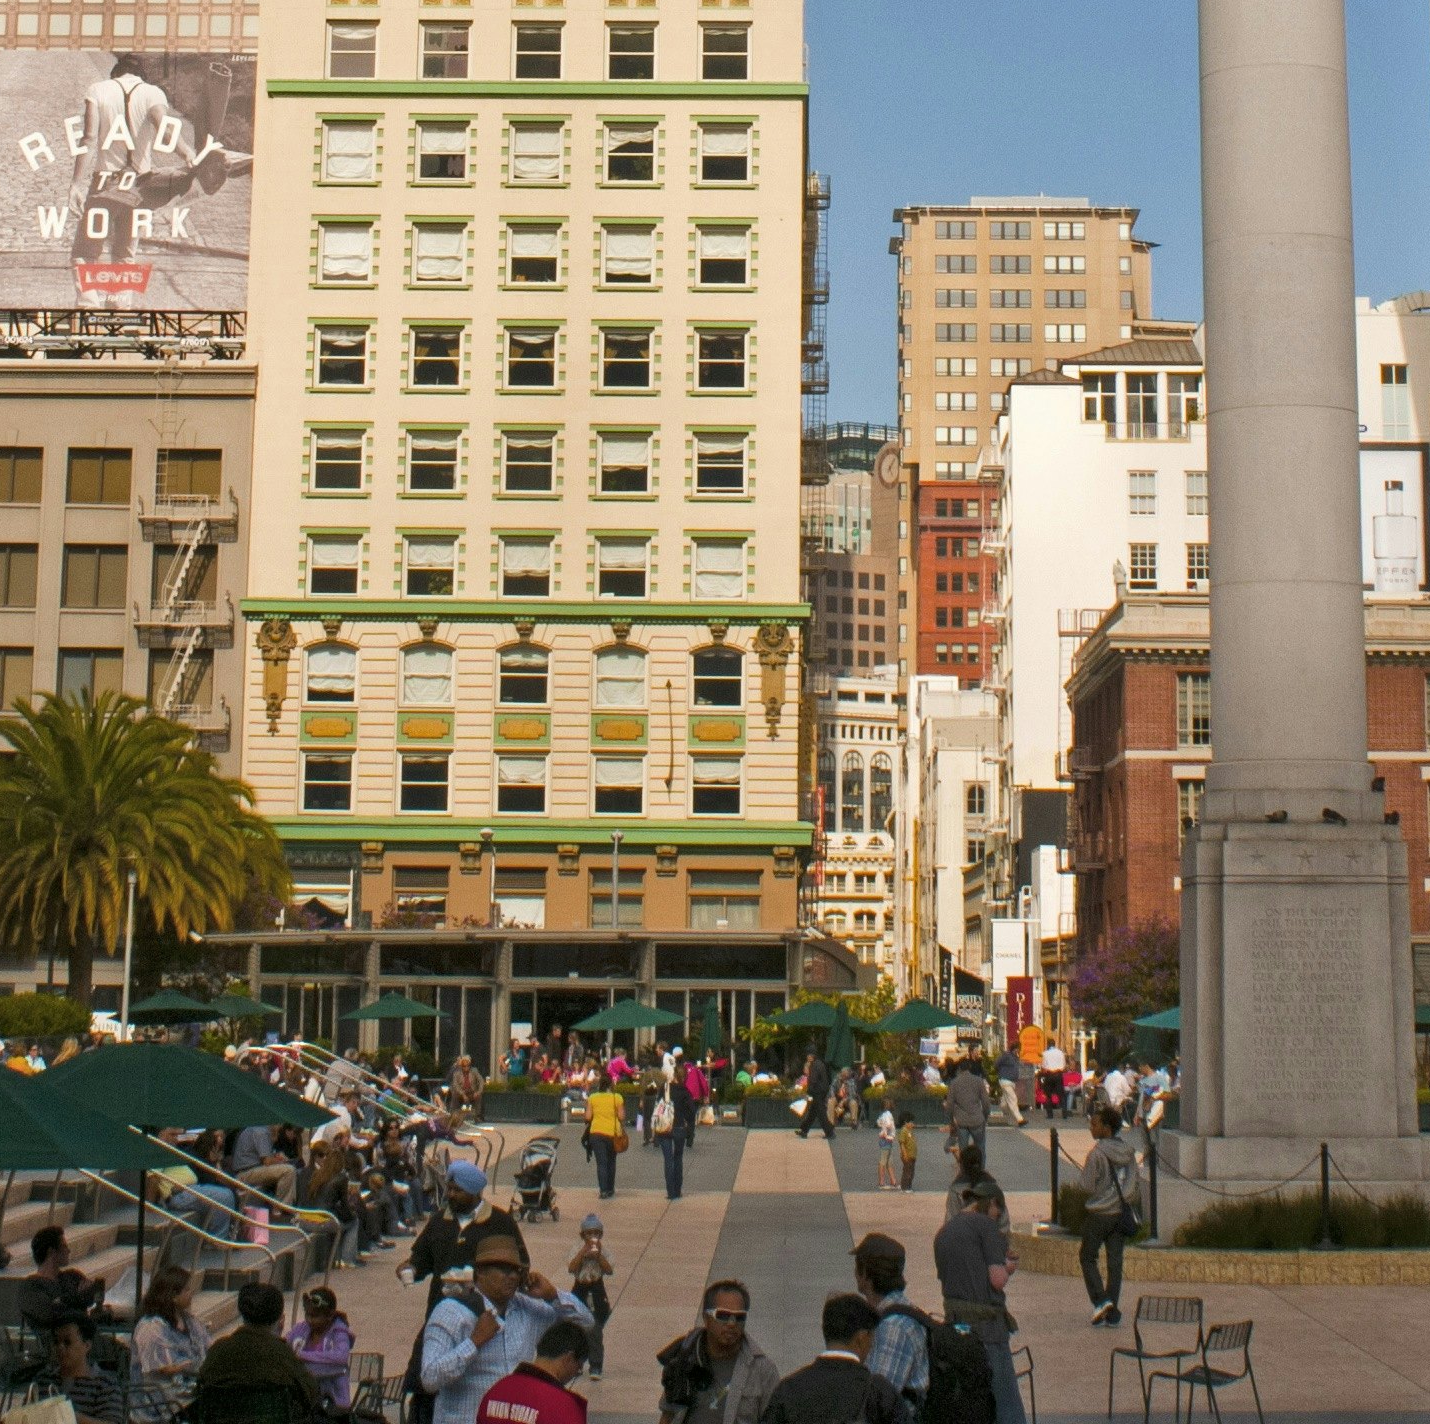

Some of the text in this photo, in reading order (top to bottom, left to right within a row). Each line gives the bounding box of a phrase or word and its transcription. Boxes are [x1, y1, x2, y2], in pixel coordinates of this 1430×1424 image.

[18, 114, 224, 171] READY
[97, 171, 137, 191] TO
[37, 205, 190, 239] WORK
[487, 1400, 540, 1424] UNION SQUARE
